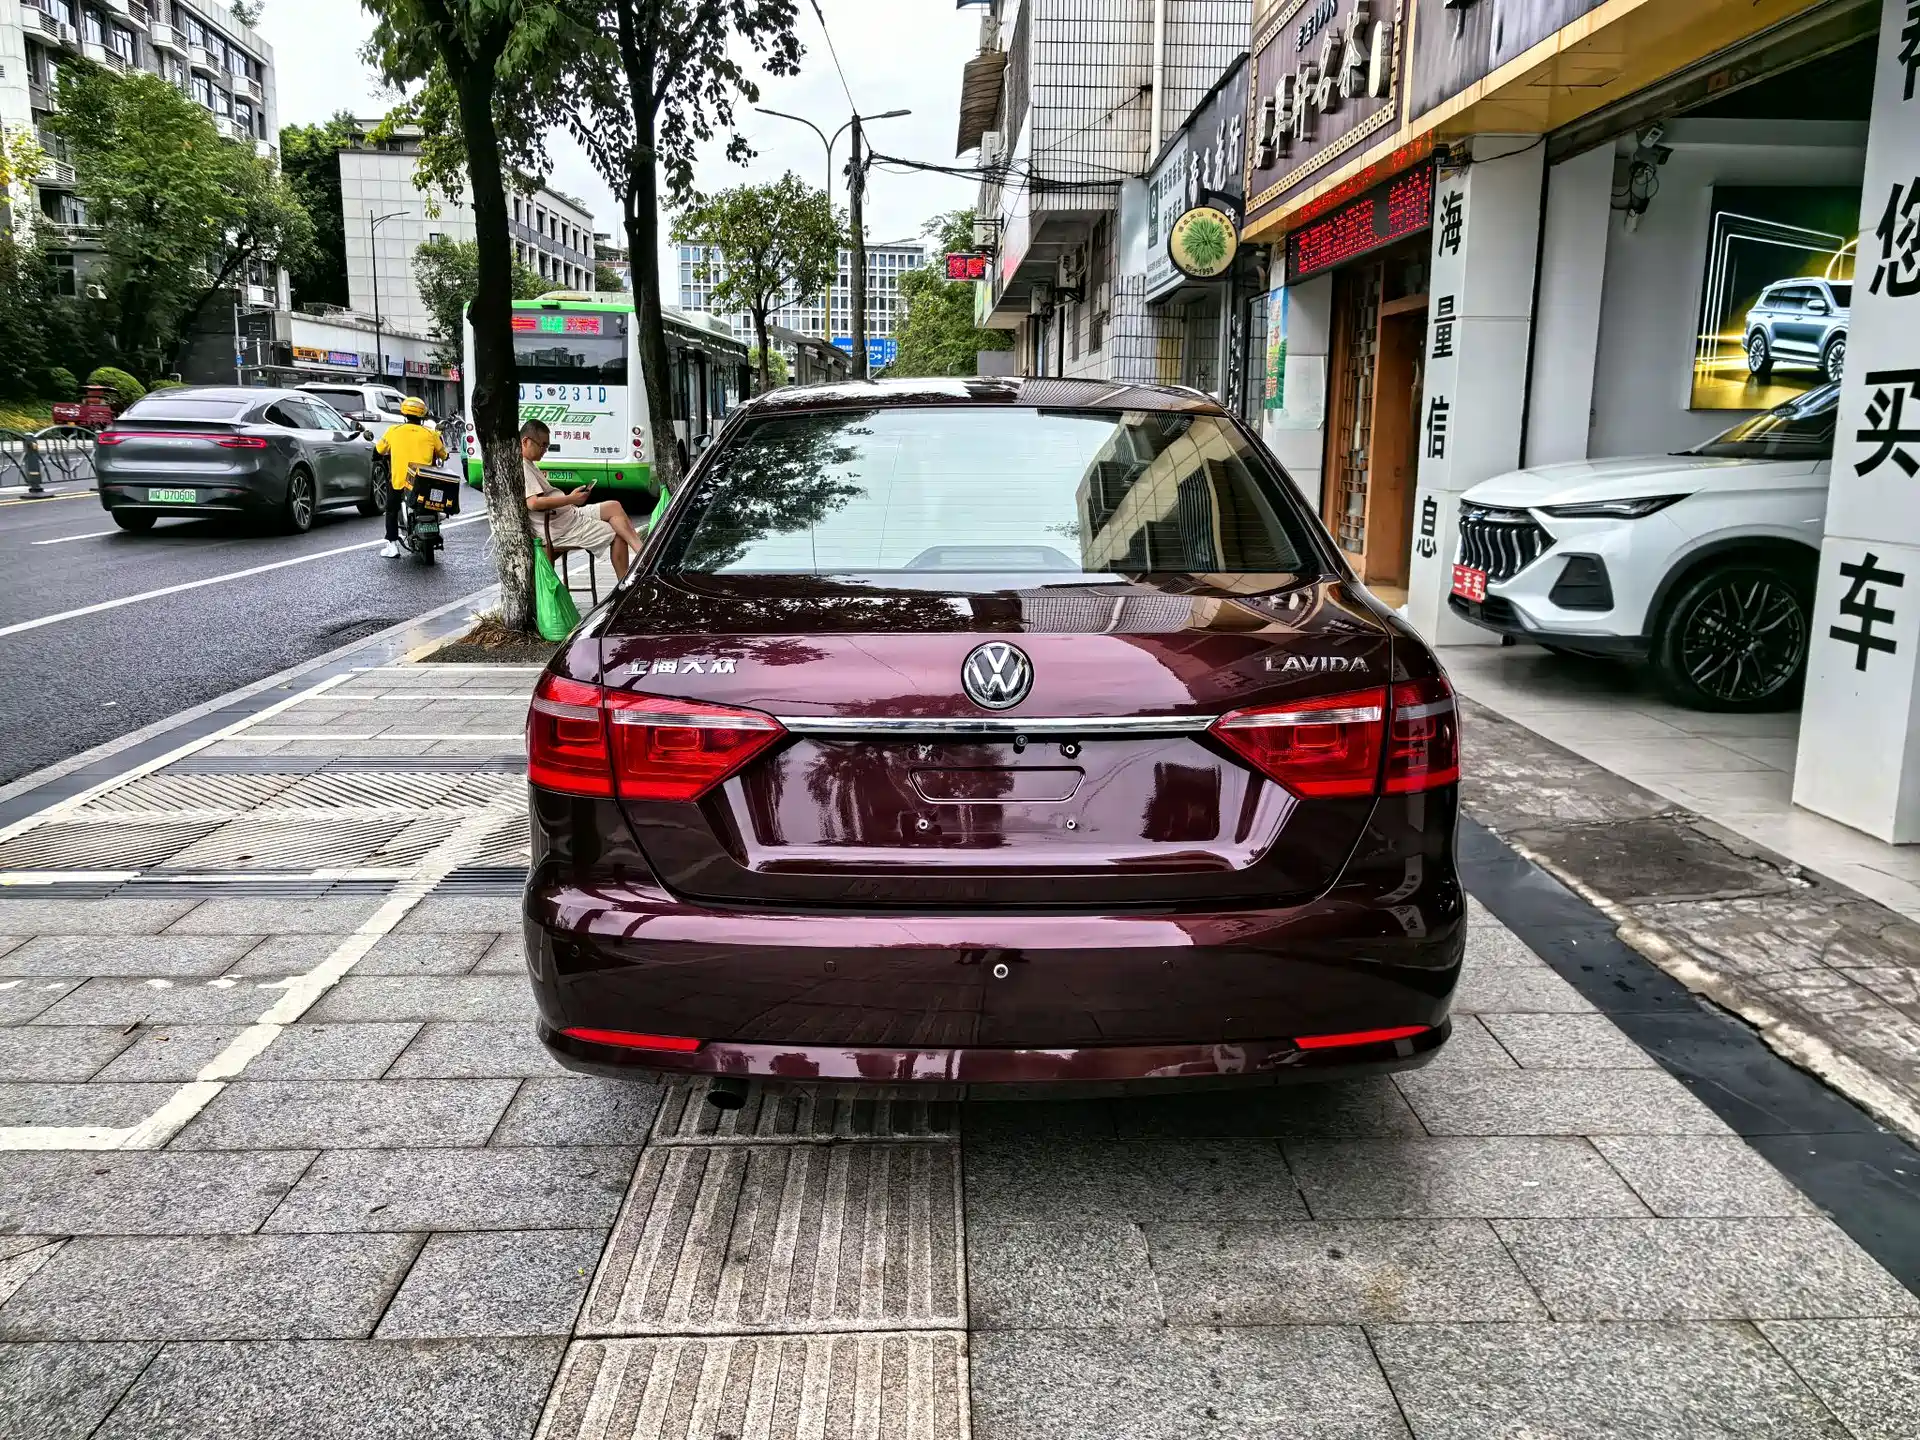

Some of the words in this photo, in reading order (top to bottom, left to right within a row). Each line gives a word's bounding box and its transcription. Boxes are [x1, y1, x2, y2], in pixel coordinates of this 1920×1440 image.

[1415, 190, 1464, 559] 海量信息
[1454, 570, 1486, 600] 二手车
[623, 657, 738, 675] 上海大众
[1265, 656, 1371, 673] LAVIDA
